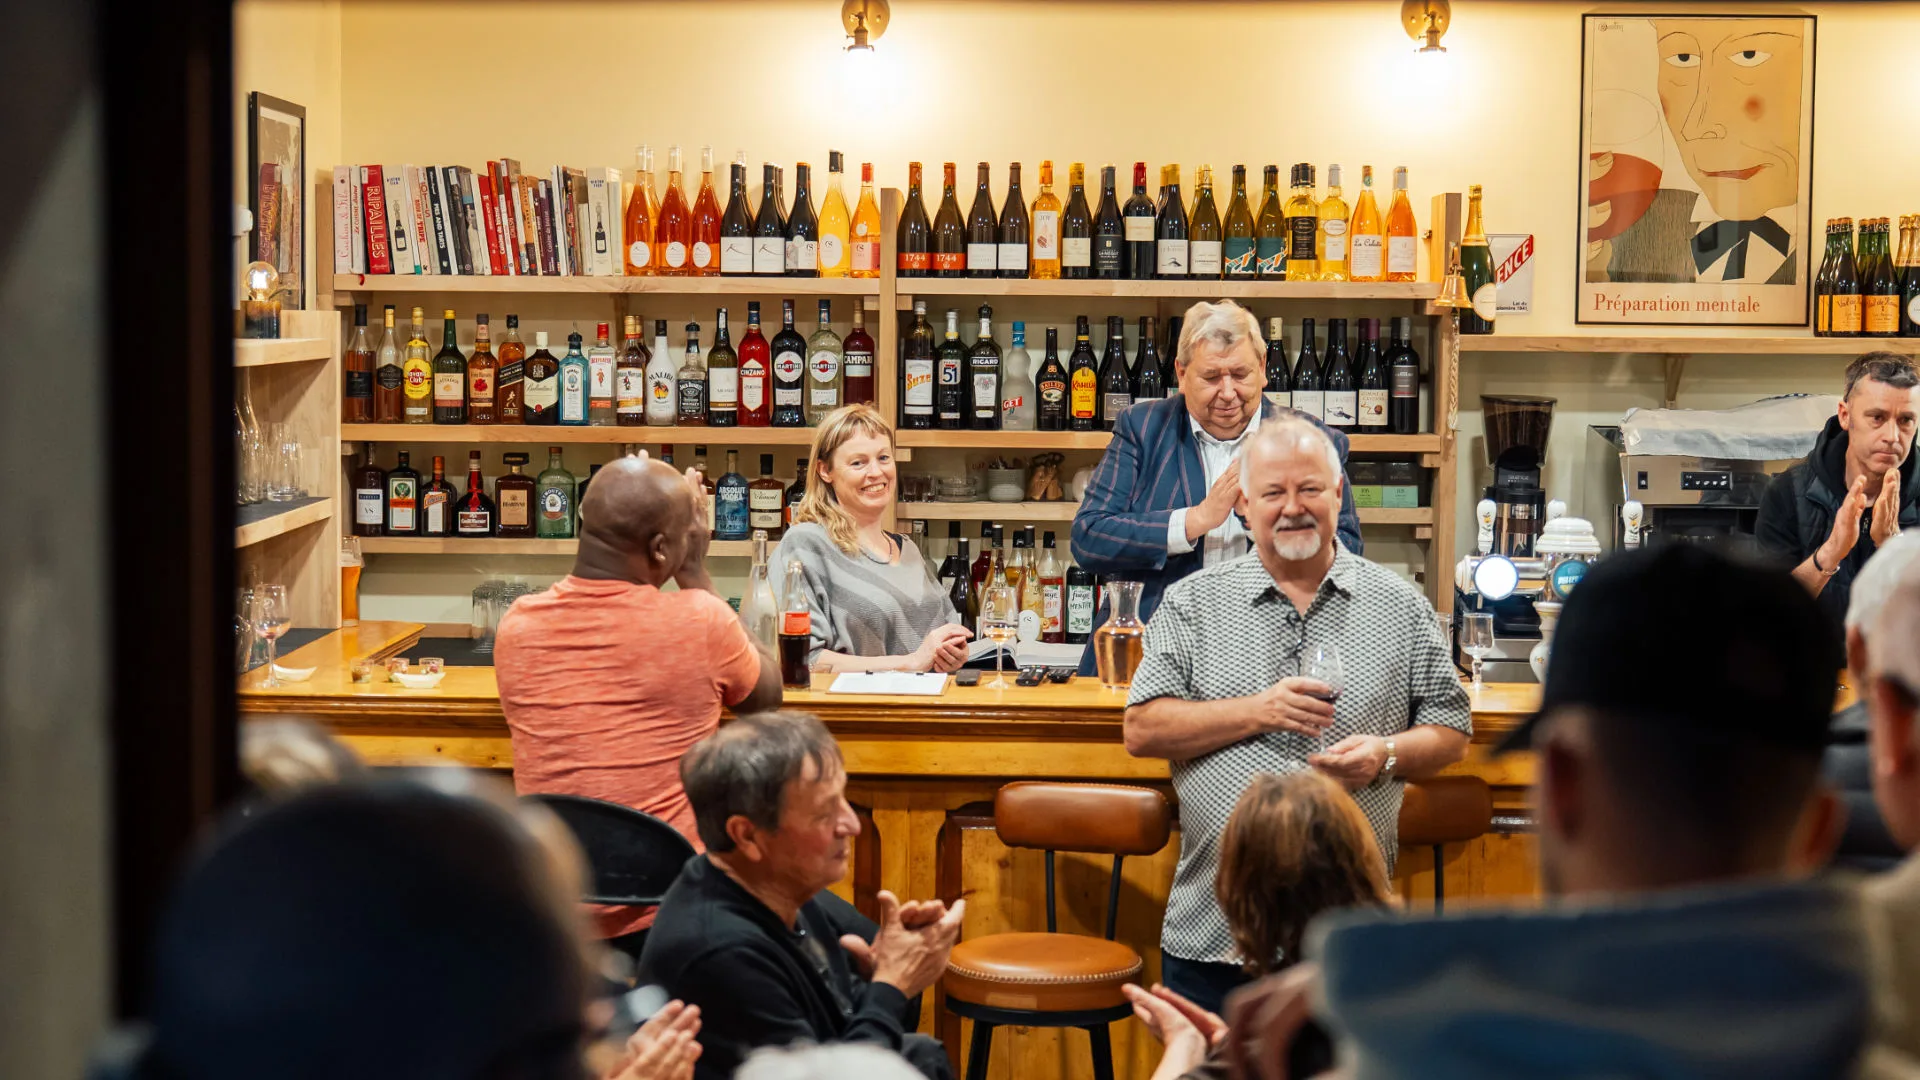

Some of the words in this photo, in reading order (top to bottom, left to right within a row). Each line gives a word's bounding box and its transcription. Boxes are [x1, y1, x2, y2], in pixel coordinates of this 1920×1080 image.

[367, 186, 385, 259] RIPAILLES
[418, 221, 426, 243] TRIPE
[437, 231, 446, 249] TARTS
[904, 254, 926, 262] 1744
[936, 254, 957, 262] 1744
[1593, 293, 1690, 316] Préparation
[1696, 296, 1760, 313] mentale
[844, 355, 873, 364] CAMPARI
[648, 371, 675, 383] MALIBU
[942, 367, 958, 382] 51
[907, 373, 931, 391] Suze
[1003, 397, 1020, 409] GET
[540, 488, 562, 505] PLYMOUTH
[718, 486, 747, 494] ABSOLUT
[721, 493, 744, 501] VODKA
